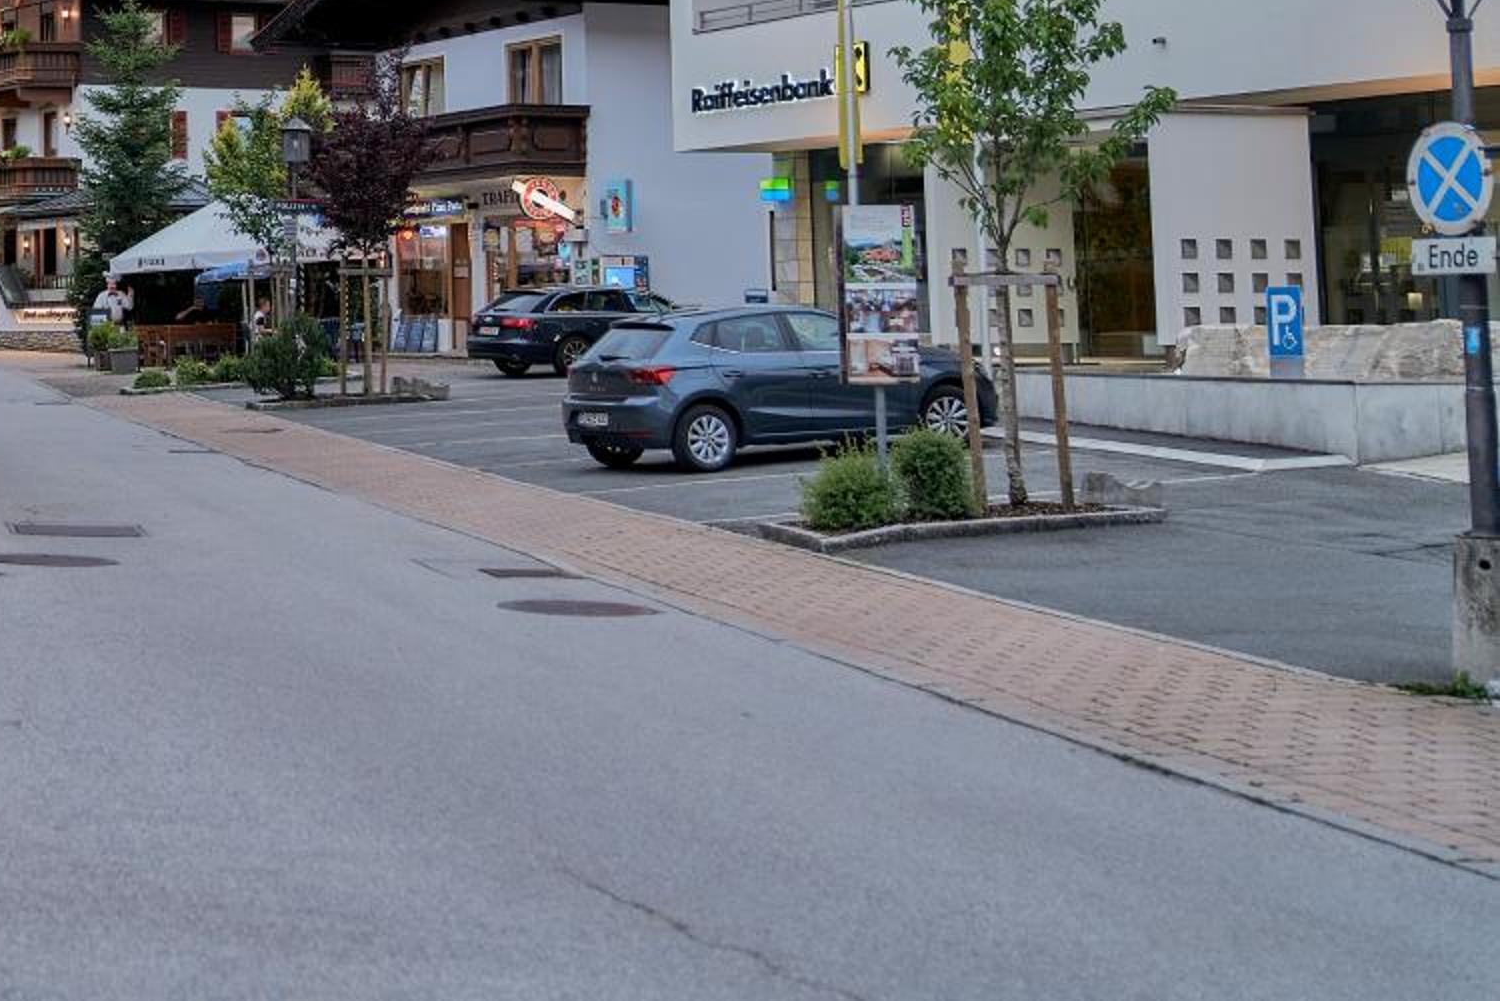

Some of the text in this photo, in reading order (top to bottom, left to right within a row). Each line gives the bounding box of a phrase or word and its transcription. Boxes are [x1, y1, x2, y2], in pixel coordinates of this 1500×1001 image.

[692, 68, 835, 112] Raiffeisenbank
[1428, 243, 1479, 269] Ende
[1270, 294, 1297, 346] P
